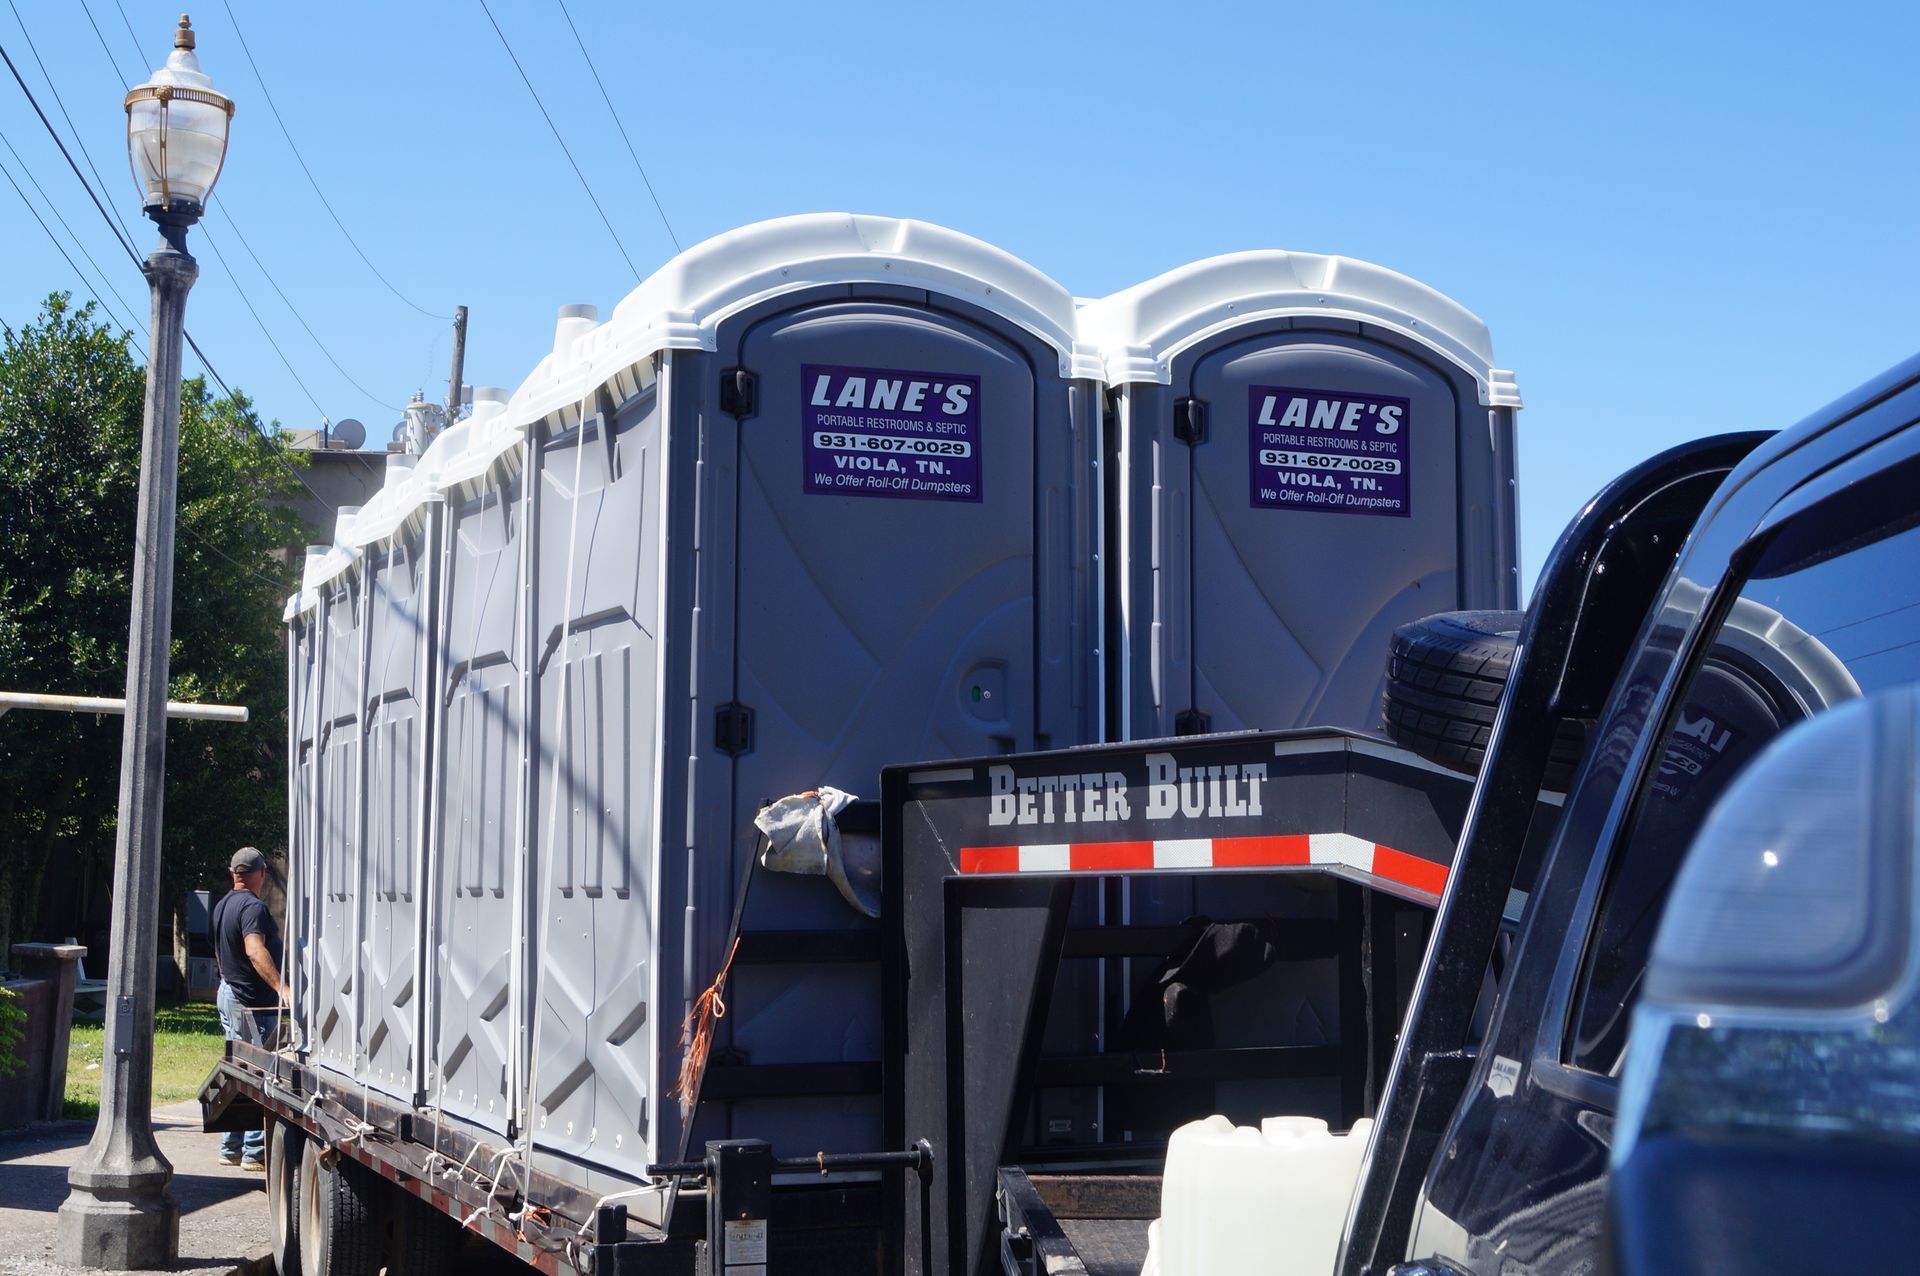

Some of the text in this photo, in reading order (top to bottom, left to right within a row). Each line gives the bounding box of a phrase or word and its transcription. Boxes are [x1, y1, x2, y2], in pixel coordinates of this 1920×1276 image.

[810, 374, 972, 415] LANE'S
[817, 414, 967, 435] PORTABLE RESTROOMS & SEPTIC
[1258, 396, 1402, 434] LANE'S
[819, 434, 966, 455] 931-607-0029
[1263, 432, 1398, 453] PORTABLE RESTROOMS & SEPTIC
[833, 455, 951, 475] VIOLA, TN.
[1265, 452, 1396, 472] 931-607-0029
[814, 472, 972, 494] We Offer Roll-Off Dumpsters
[1277, 471, 1383, 491] VIOLA, TN.
[1260, 487, 1401, 509] We Offer Roll-Off Dumpsters
